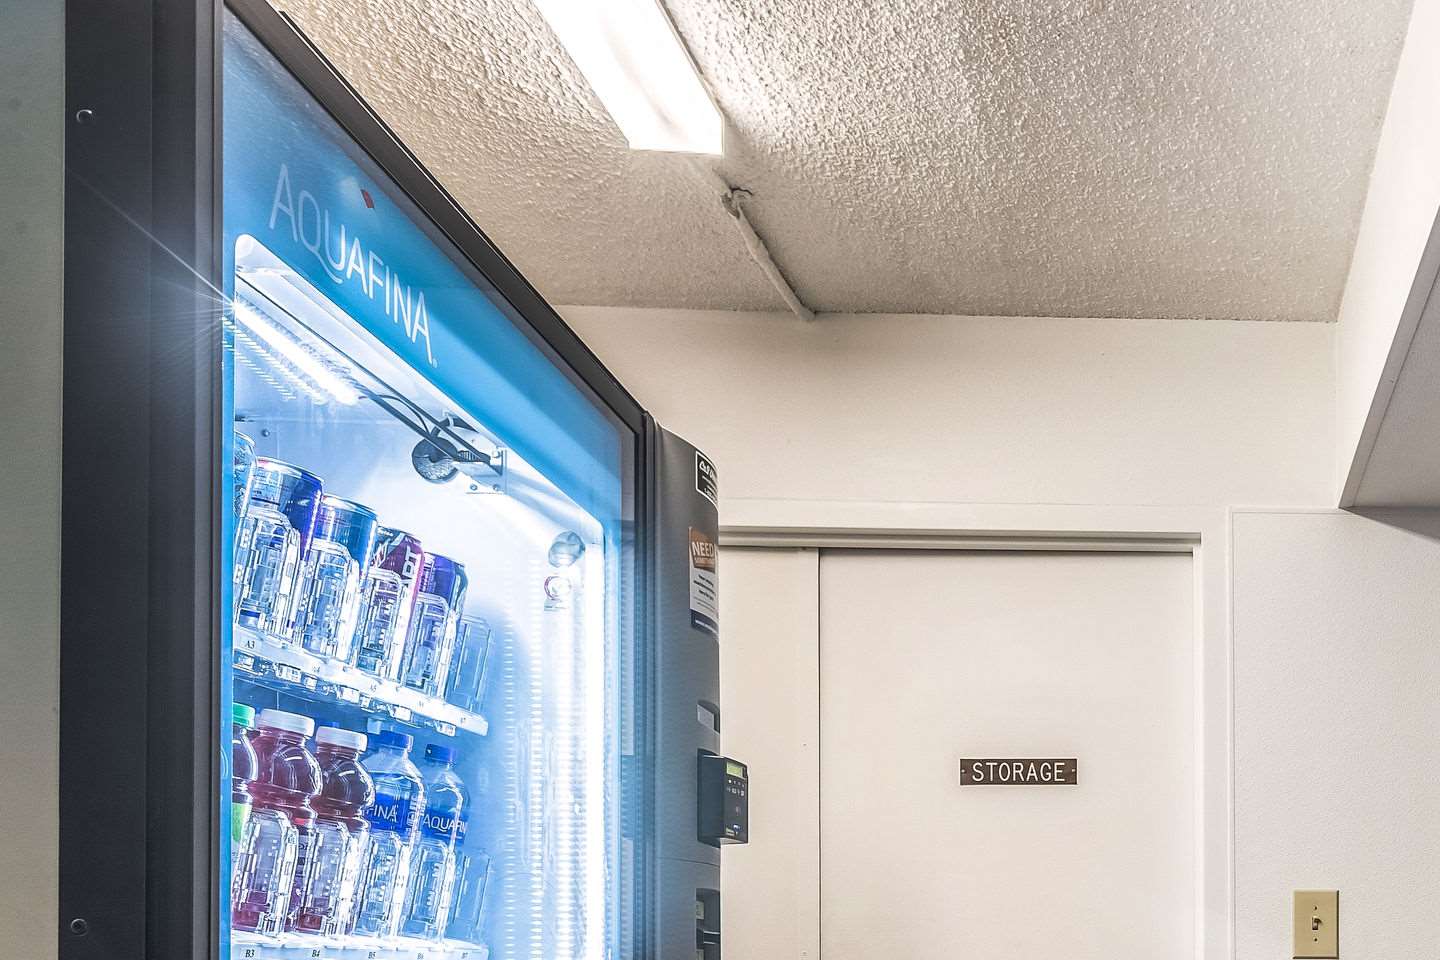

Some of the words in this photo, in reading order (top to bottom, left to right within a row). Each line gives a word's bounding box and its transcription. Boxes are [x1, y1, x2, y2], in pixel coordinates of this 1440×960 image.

[269, 163, 433, 364] AQUAFINA
[691, 541, 714, 558] NEED
[244, 640, 255, 650] A3
[972, 762, 1065, 781] STORAGE
[245, 949, 255, 958] B3
[312, 949, 320, 958] B4
